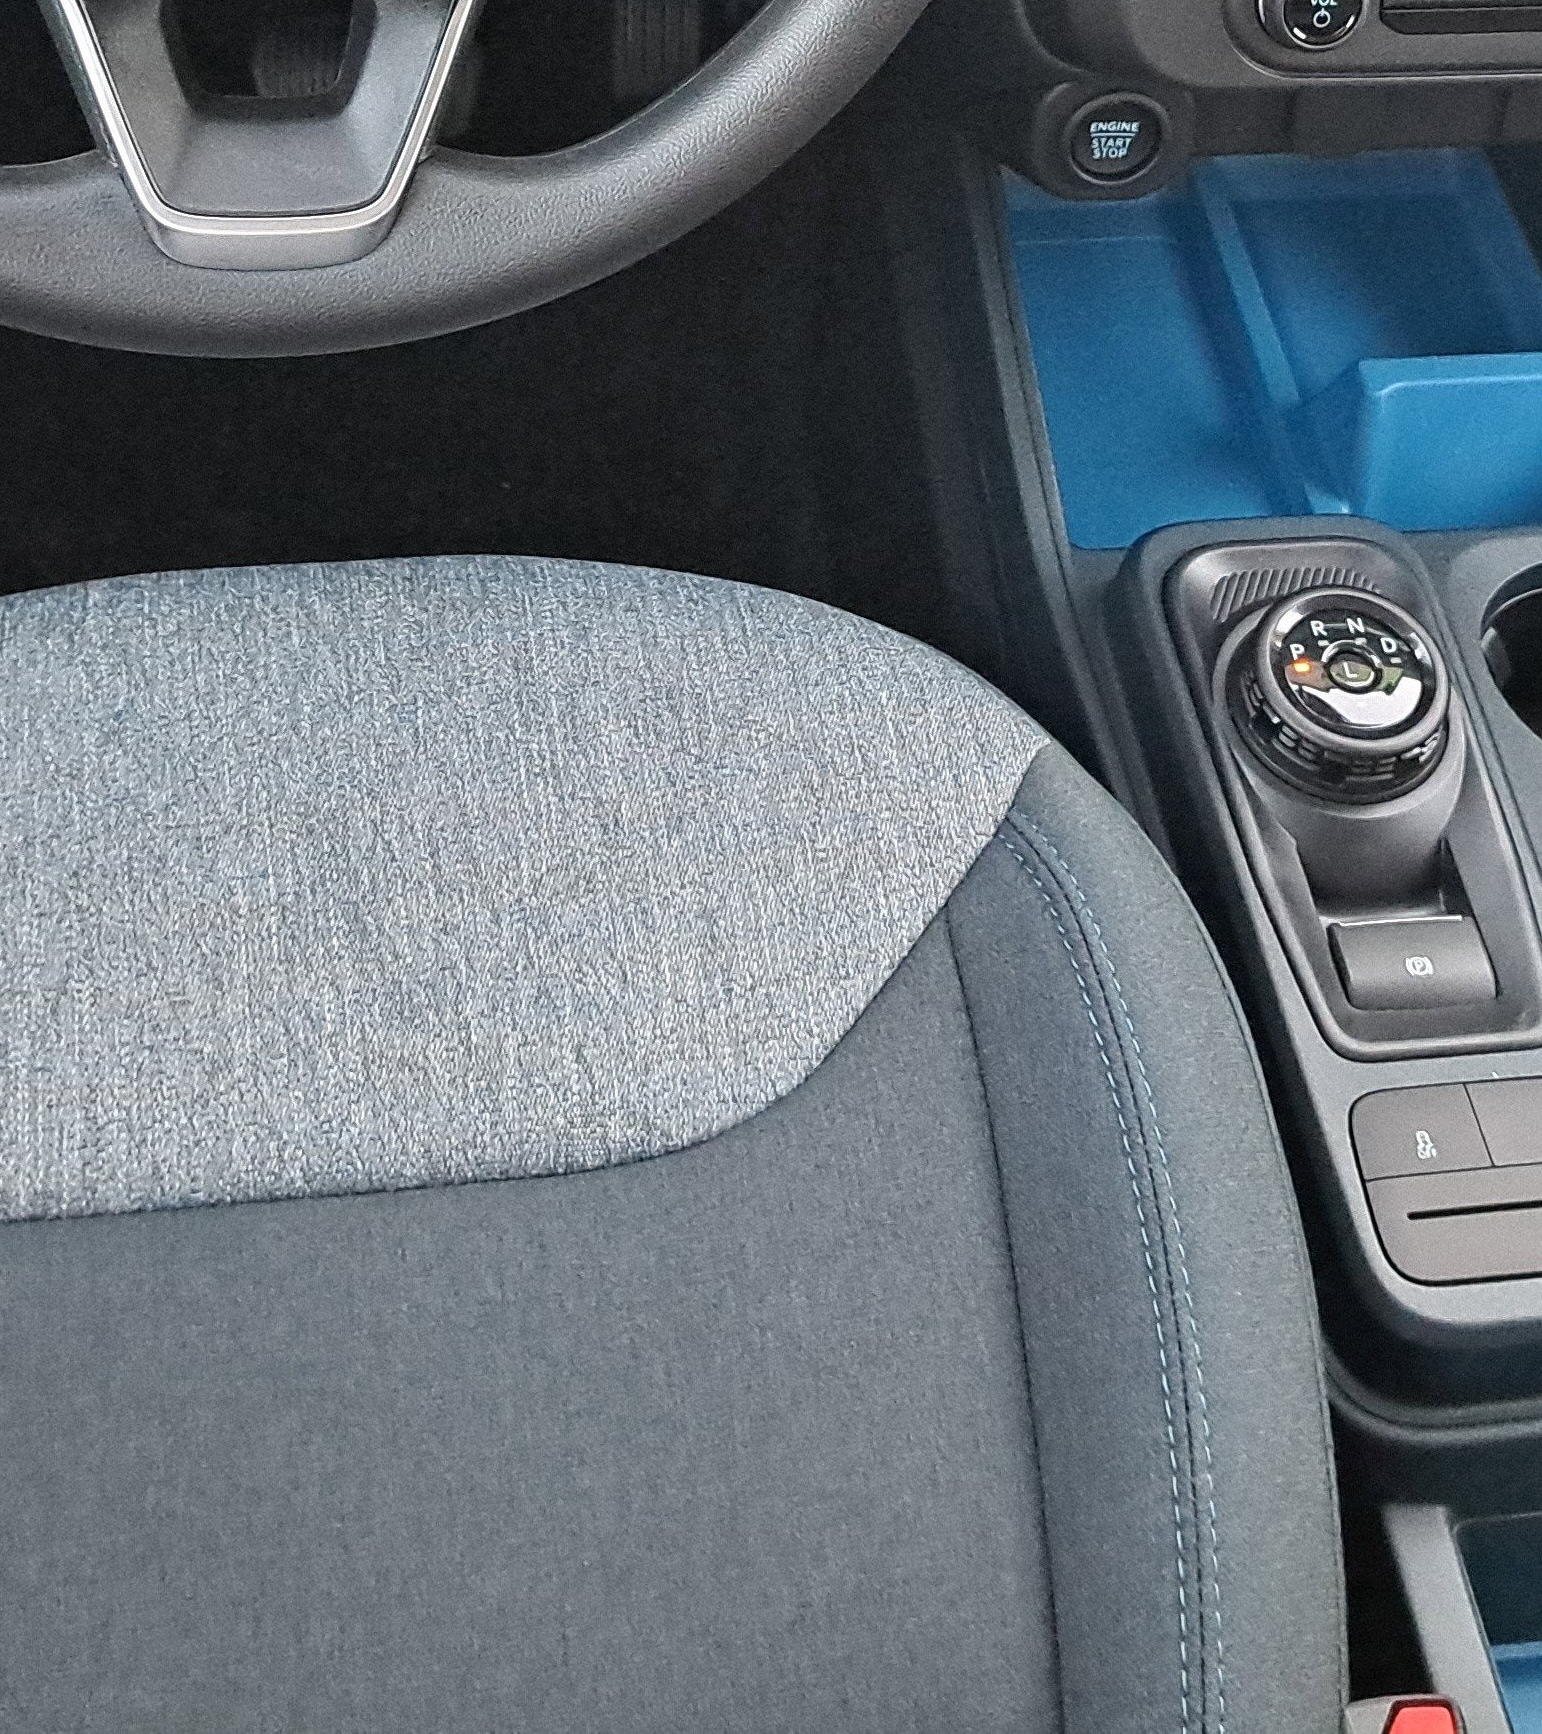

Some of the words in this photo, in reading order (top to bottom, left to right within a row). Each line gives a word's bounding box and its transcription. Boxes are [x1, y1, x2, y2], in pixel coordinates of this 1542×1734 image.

[1089, 120, 1141, 133] ENGINE
[1091, 137, 1132, 149] START
[1092, 147, 1128, 159] STOP
[1311, 621, 1327, 636] R
[1347, 618, 1365, 634] N
[1290, 644, 1305, 660] P
[1380, 637, 1397, 653] D
[1343, 662, 1358, 678] L
